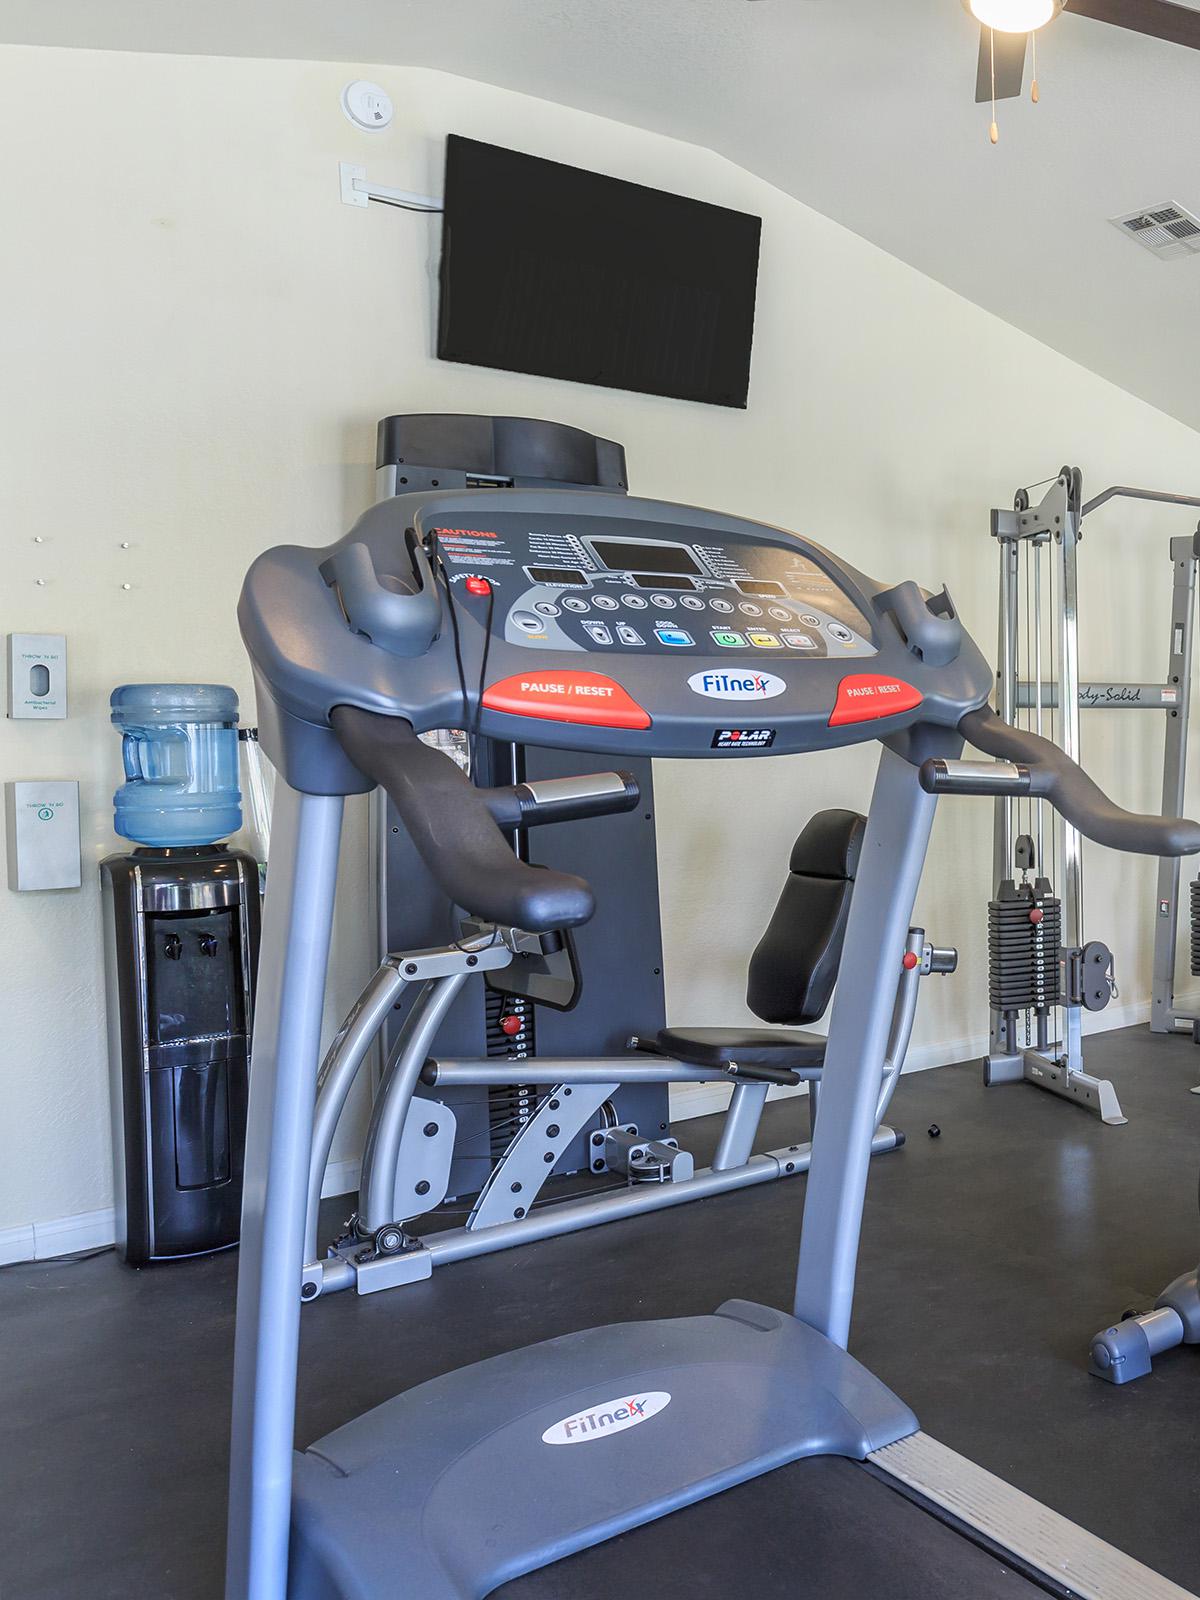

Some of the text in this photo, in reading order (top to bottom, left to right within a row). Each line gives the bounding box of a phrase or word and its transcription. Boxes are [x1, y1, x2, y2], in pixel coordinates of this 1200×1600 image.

[434, 527, 497, 538] CAUTIONS
[521, 682, 564, 693] PAUSE
[575, 685, 614, 697] RESET
[847, 687, 874, 697] PAUSE
[878, 684, 901, 694] RESET
[718, 730, 771, 740] POLAR
